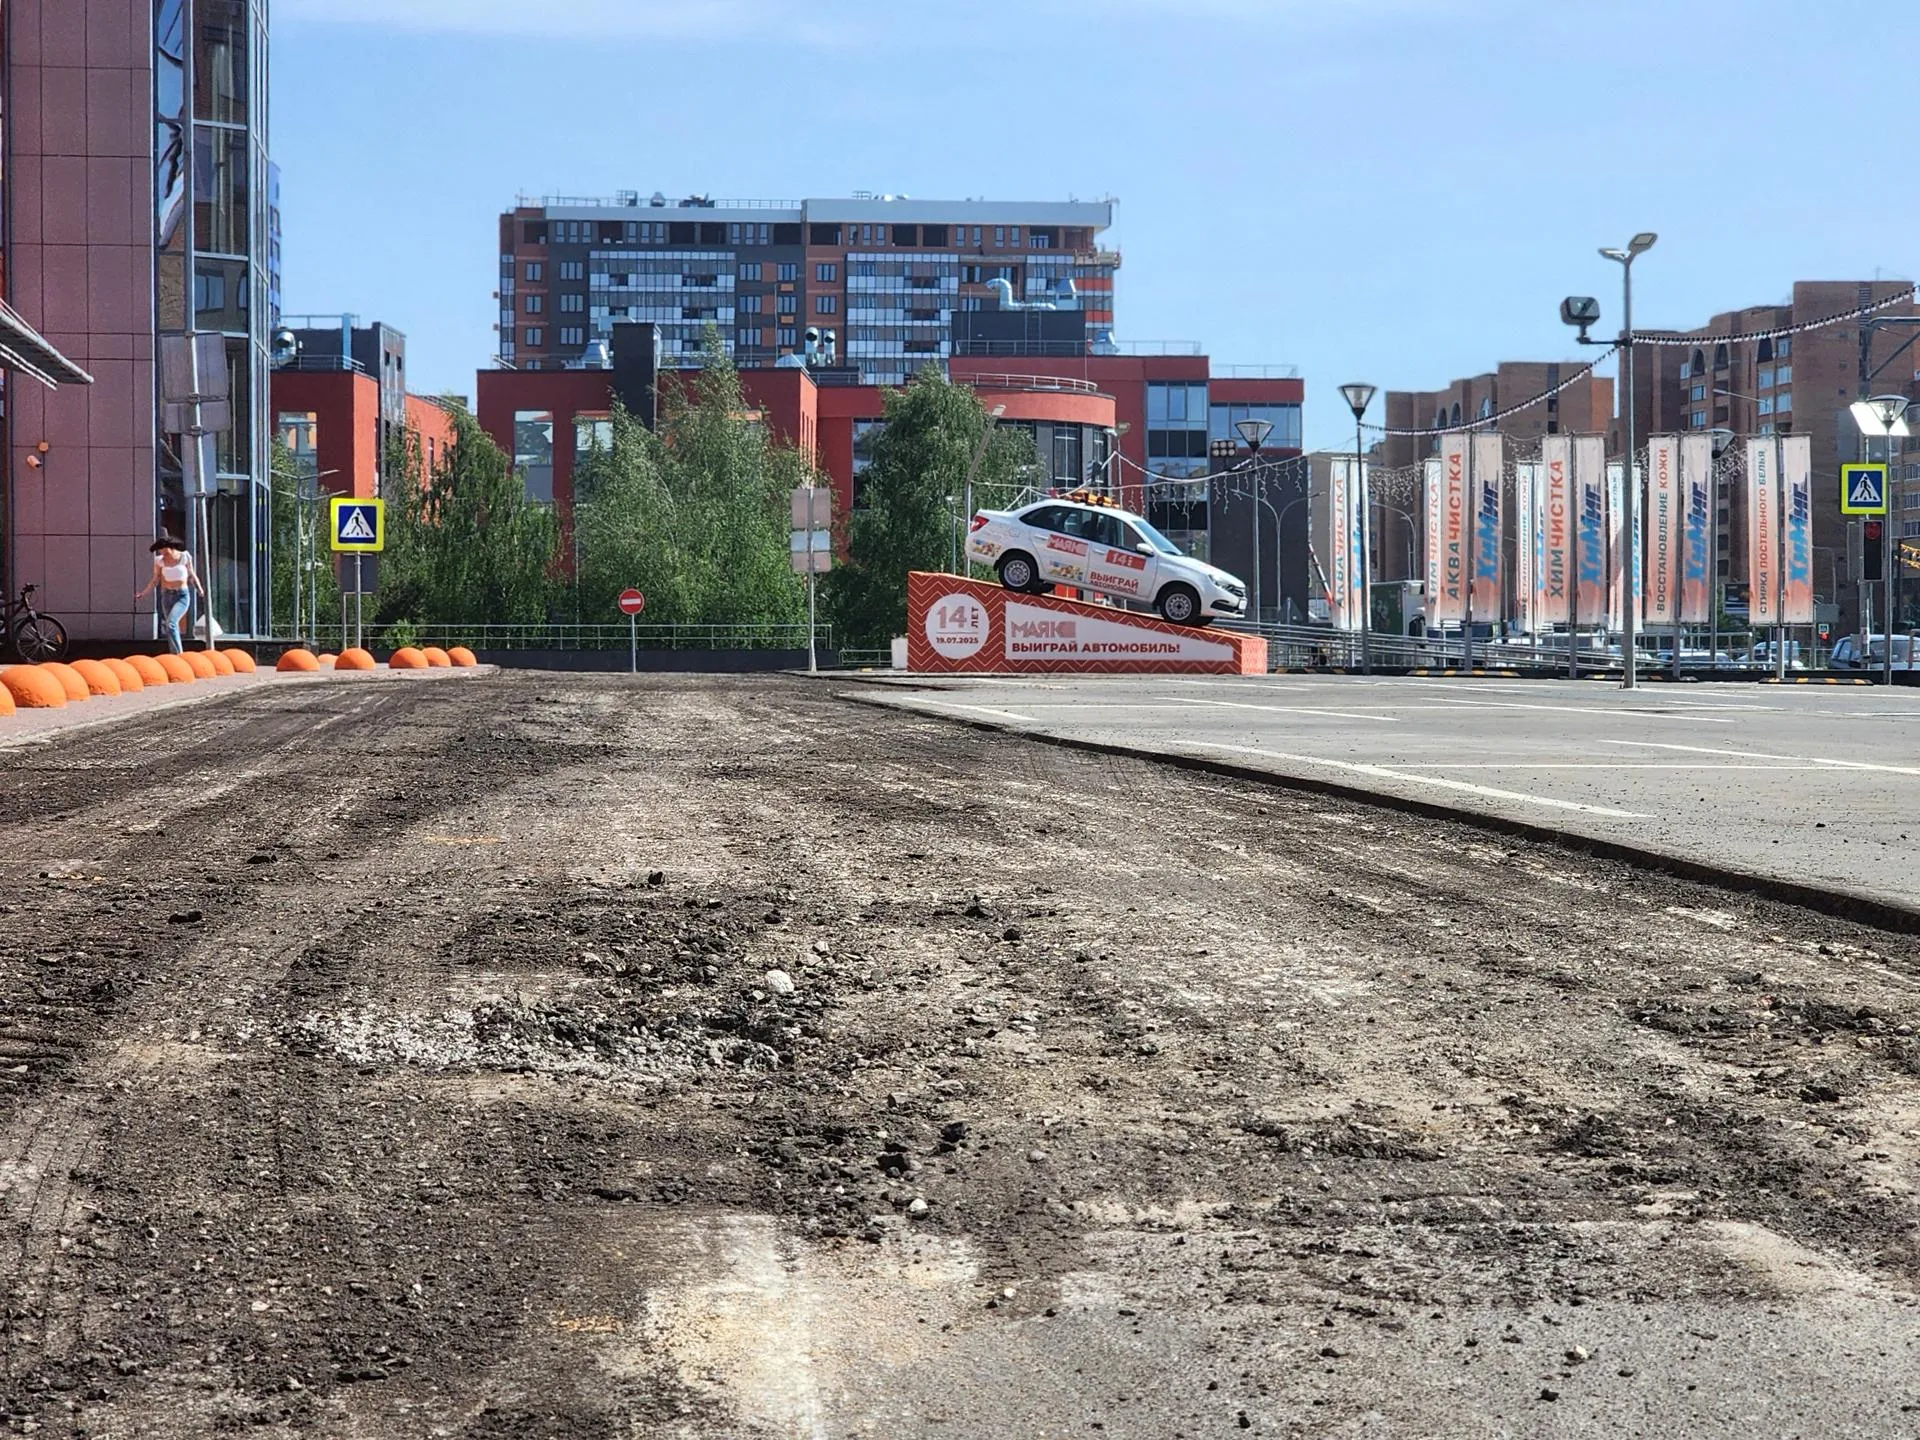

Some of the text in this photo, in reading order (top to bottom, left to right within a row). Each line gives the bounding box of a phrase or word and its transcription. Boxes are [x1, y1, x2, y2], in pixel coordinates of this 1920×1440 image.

[1447, 453, 1461, 600] АКВАЧИСТКА
[1550, 460, 1564, 599] ХИМЧИСТКА
[1657, 448, 1668, 612] ВОССТАНОВЛЕНИЕ КОЖИ
[1759, 488, 1767, 568] ПОСТЕЛЬНОГО
[1090, 571, 1139, 588] ВЫИГРАЙ
[1111, 553, 1126, 565] 14
[1760, 572, 1768, 614] СТИРКА
[937, 605, 979, 629] 14 ЛЕТ
[1012, 640, 1181, 653] ВЫИГРАЙ АВТОМОБИЛЬ!
